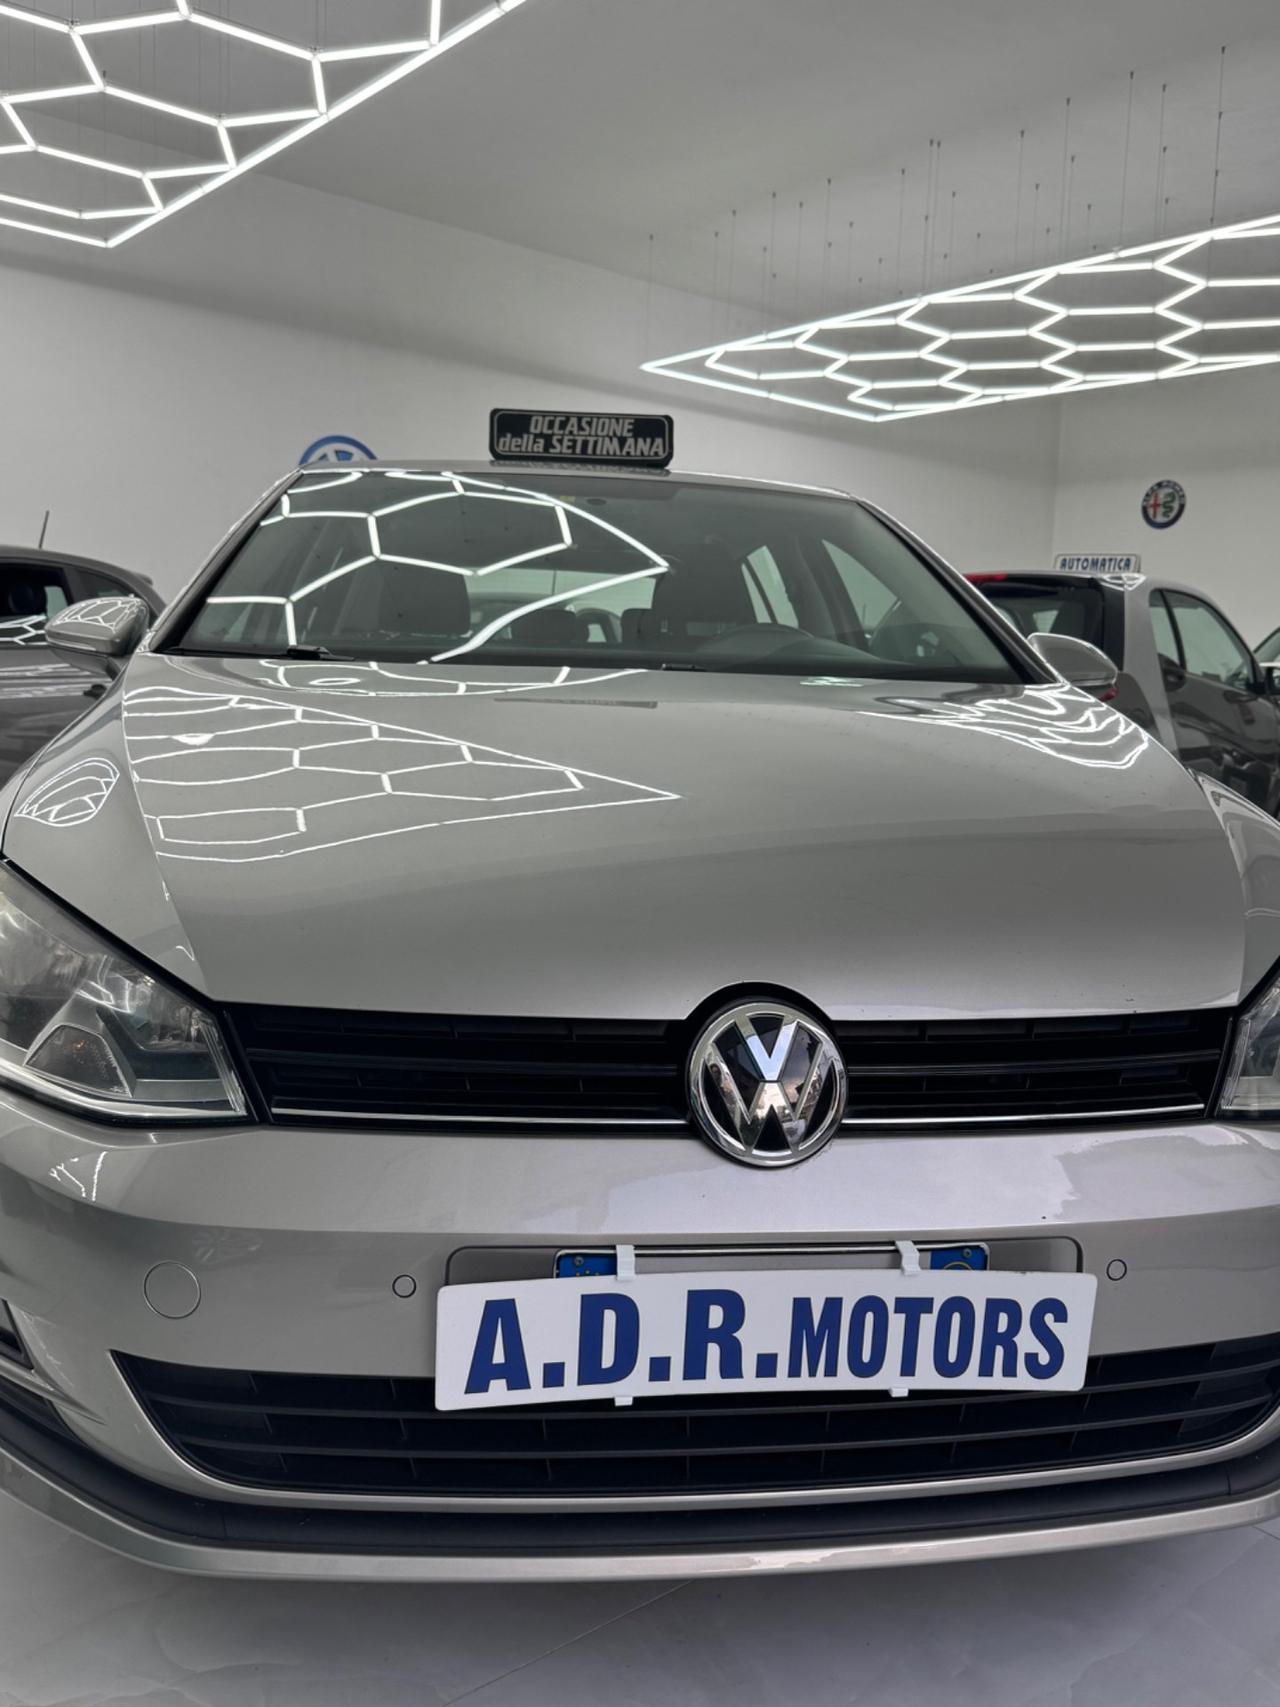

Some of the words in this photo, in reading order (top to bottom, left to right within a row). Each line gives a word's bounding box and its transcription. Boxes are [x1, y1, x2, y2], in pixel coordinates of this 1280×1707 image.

[529, 415, 635, 437] OCCASIONE
[499, 433, 544, 452] della
[550, 436, 664, 456] SETTIMANA
[1060, 557, 1131, 570] AUTOMATICA
